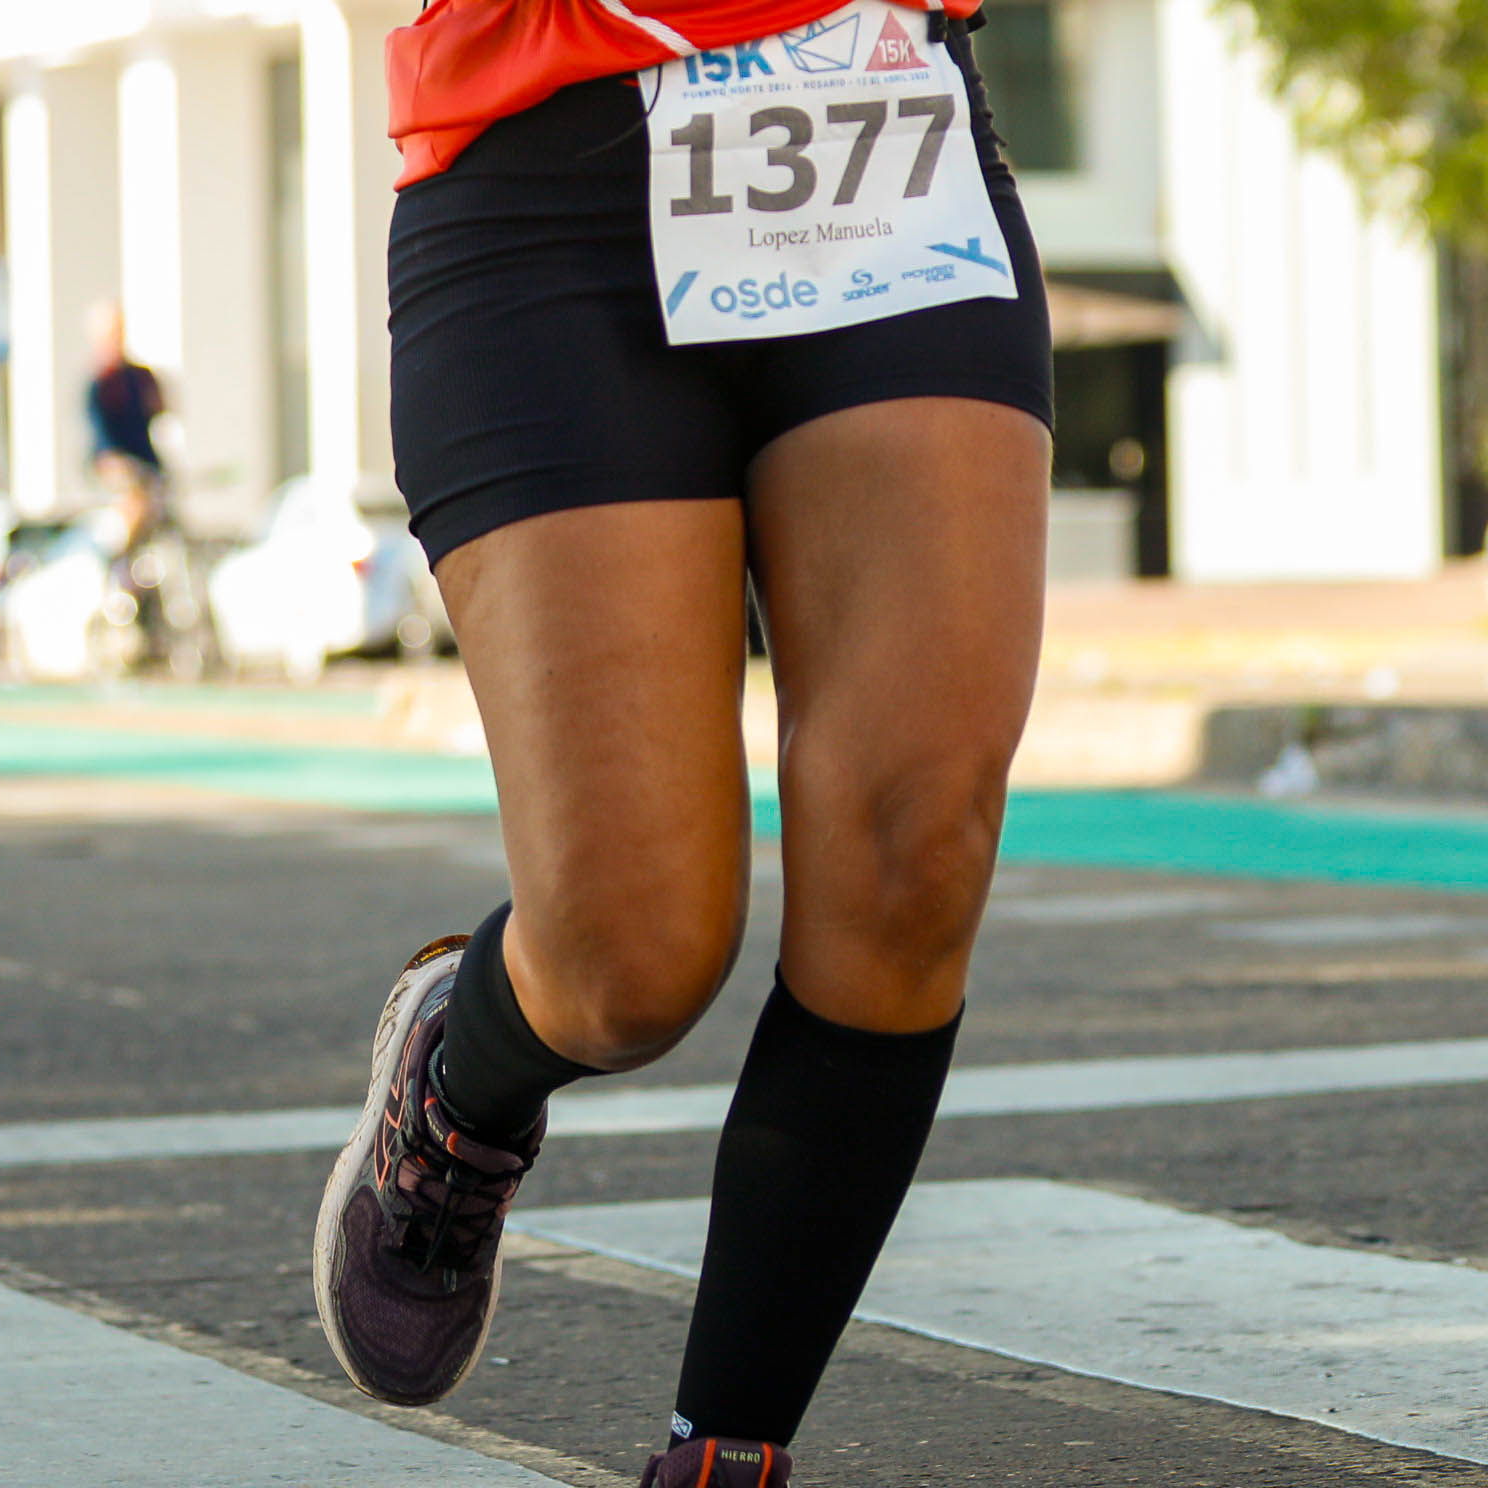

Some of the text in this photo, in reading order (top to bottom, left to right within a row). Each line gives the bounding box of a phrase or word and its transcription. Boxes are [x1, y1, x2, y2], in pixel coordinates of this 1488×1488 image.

[684, 38, 776, 85] 15K
[878, 39, 912, 64] 15K
[670, 94, 956, 217] 1377
[748, 217, 894, 251] Lopez Manuela
[710, 271, 819, 313] osde
[720, 1448, 761, 1463] HIERRO
